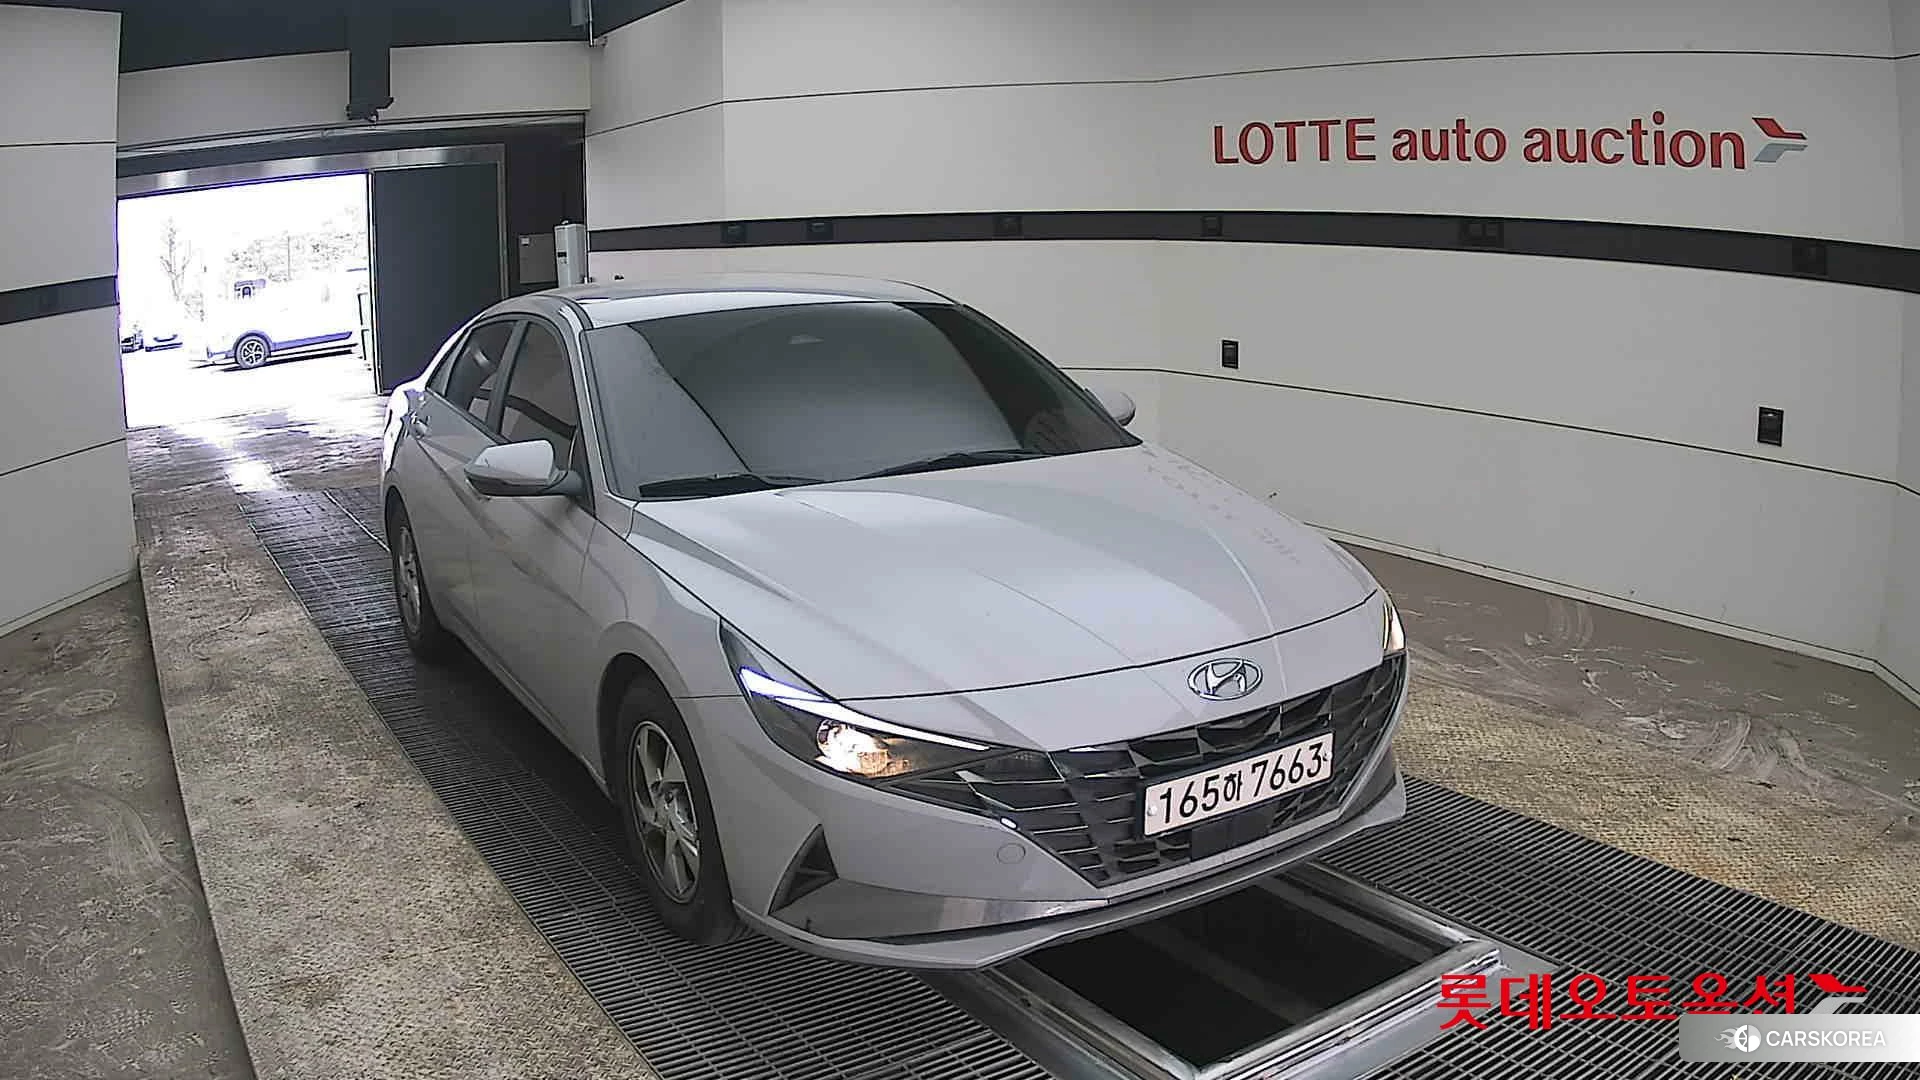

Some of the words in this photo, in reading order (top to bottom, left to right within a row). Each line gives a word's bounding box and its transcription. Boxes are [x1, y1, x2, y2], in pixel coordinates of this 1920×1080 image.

[1213, 118, 1376, 164] LOTTE
[1392, 118, 1507, 162] auto
[1523, 111, 1746, 169] auction
[1160, 771, 1243, 824] 165하
[1251, 742, 1324, 797] 7663
